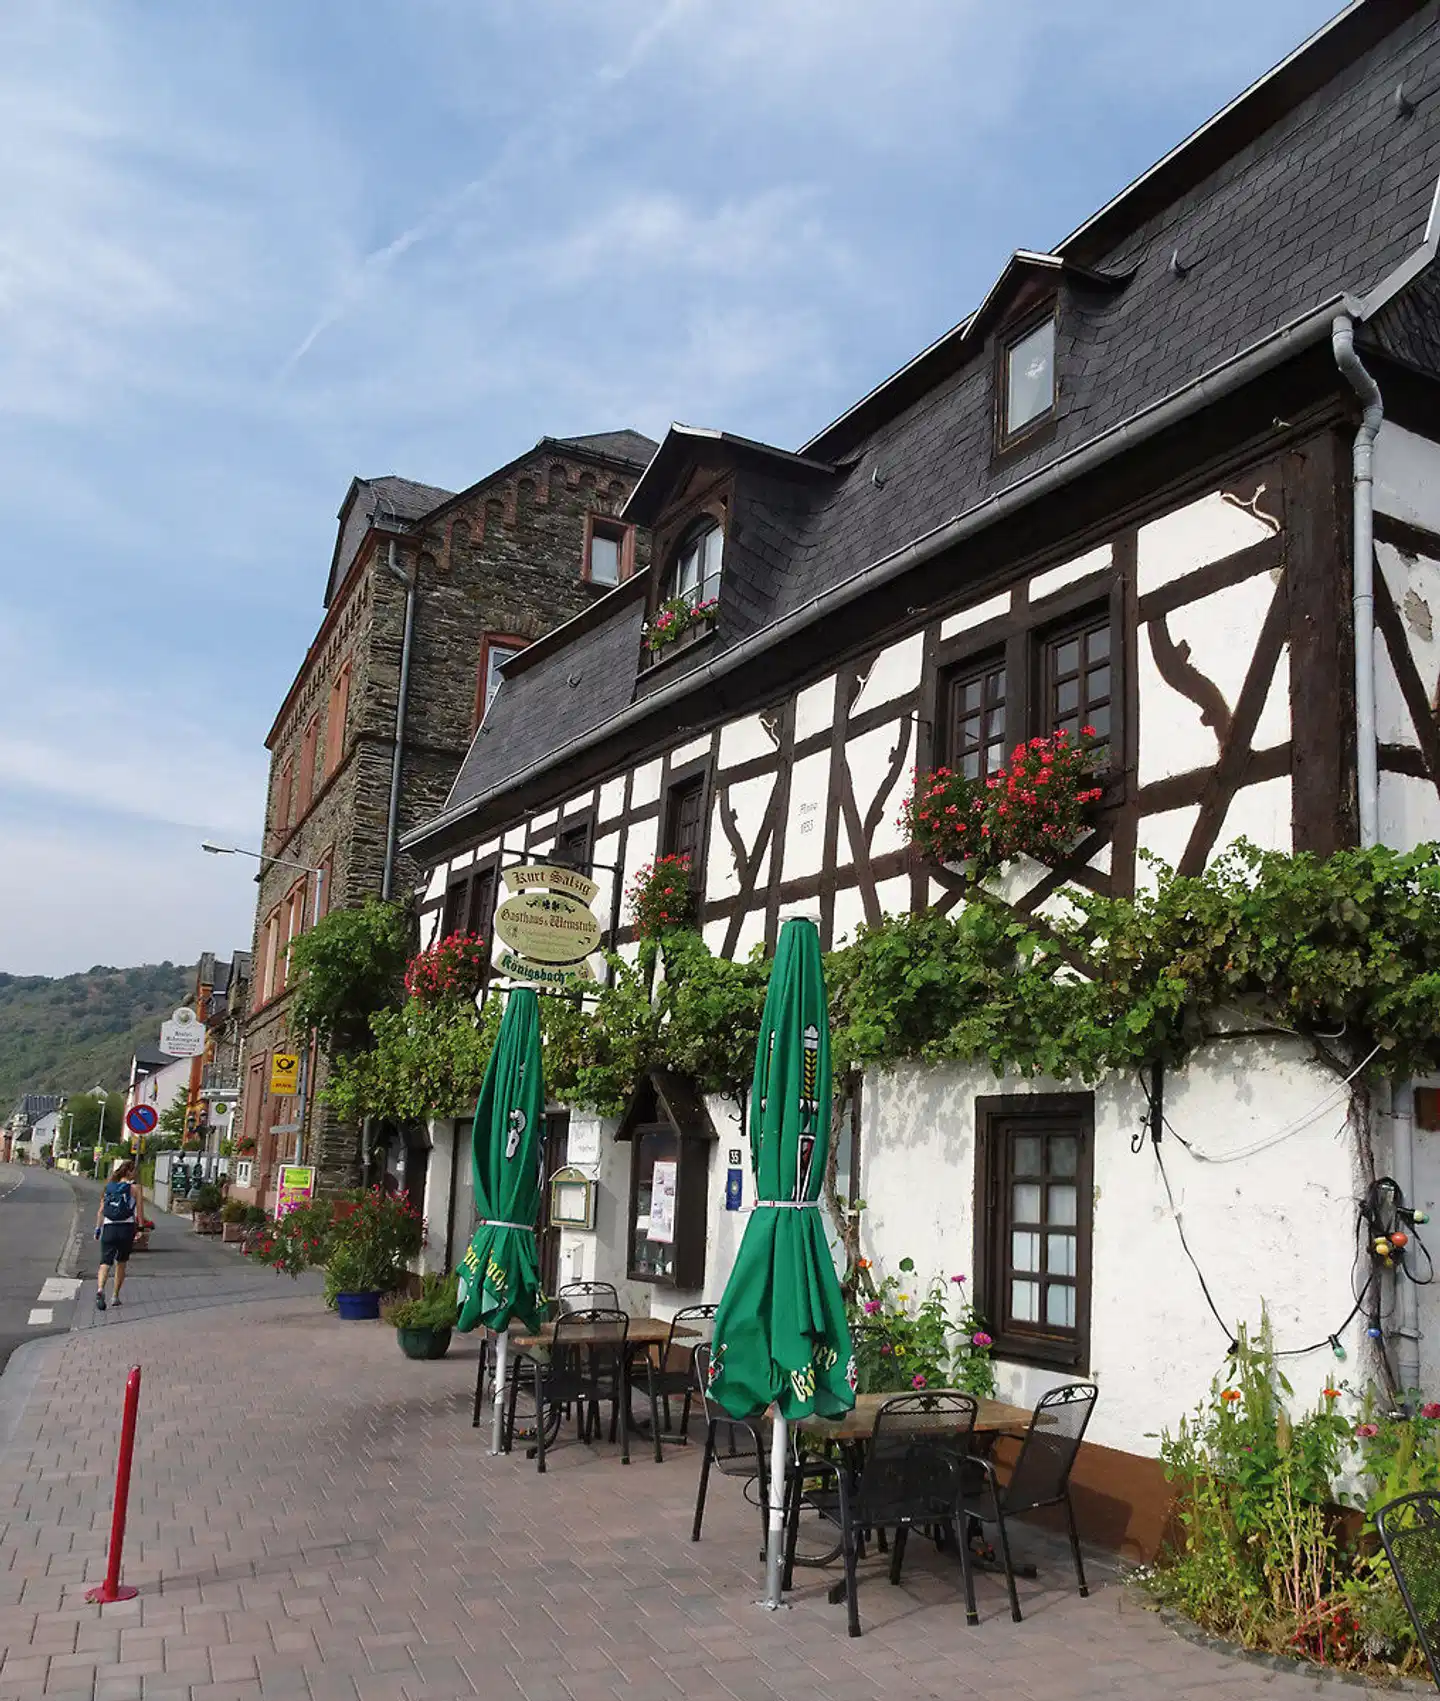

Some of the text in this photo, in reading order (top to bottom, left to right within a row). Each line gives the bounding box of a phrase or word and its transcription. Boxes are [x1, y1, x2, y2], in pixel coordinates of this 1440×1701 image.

[512, 870, 591, 895] Kurt Salzig
[501, 909, 544, 926] Gasthaus
[730, 1151, 739, 1164] 35
